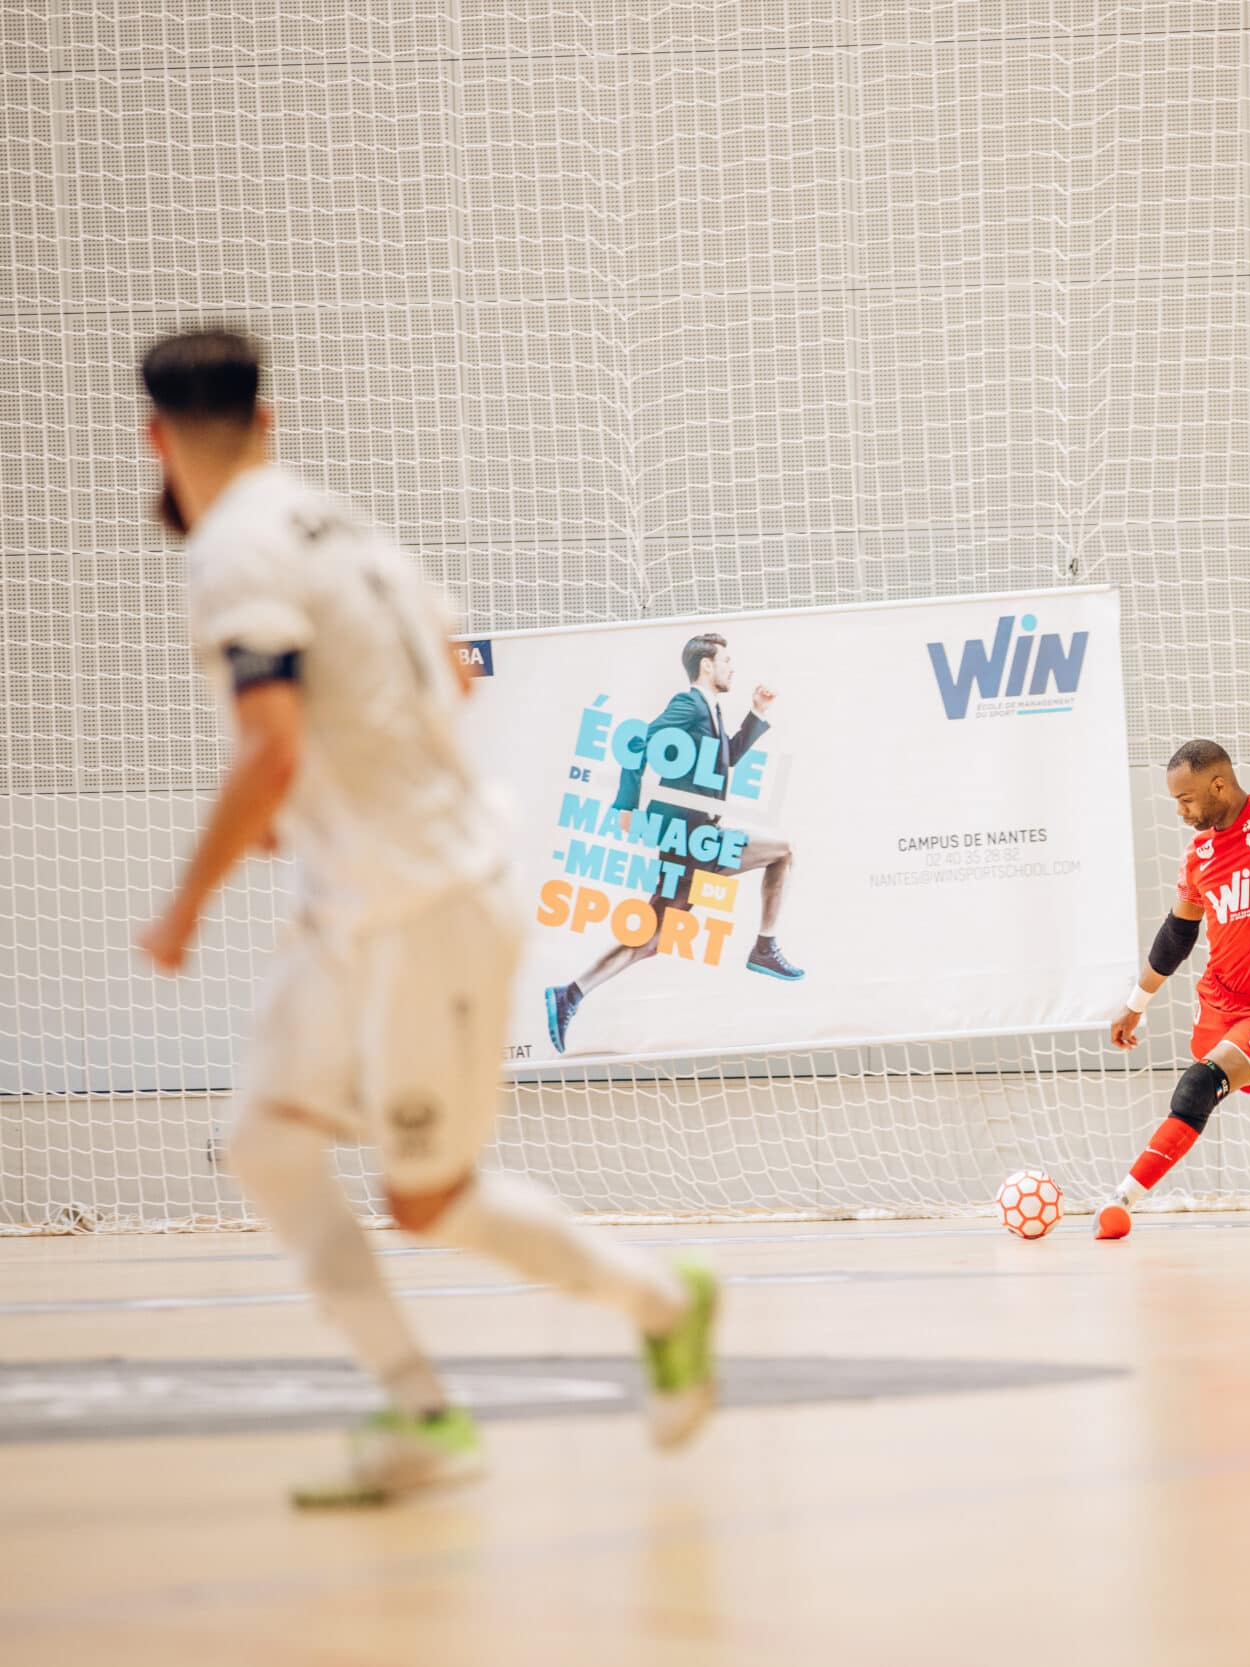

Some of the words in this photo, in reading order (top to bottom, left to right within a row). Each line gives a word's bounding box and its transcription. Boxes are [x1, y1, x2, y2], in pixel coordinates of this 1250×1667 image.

[454, 647, 485, 665] BA
[574, 694, 768, 800] ÉCOLE
[569, 766, 591, 783] DE
[557, 792, 749, 870] MANAGE
[898, 835, 959, 851] CAMPUS
[964, 833, 982, 848] DE
[987, 828, 1048, 845] NANTES
[926, 853, 941, 867] 02
[945, 851, 961, 866] 40
[966, 850, 981, 864] 35
[701, 883, 727, 900] DU
[536, 879, 734, 967] SPORT
[503, 1044, 534, 1060] TAT
